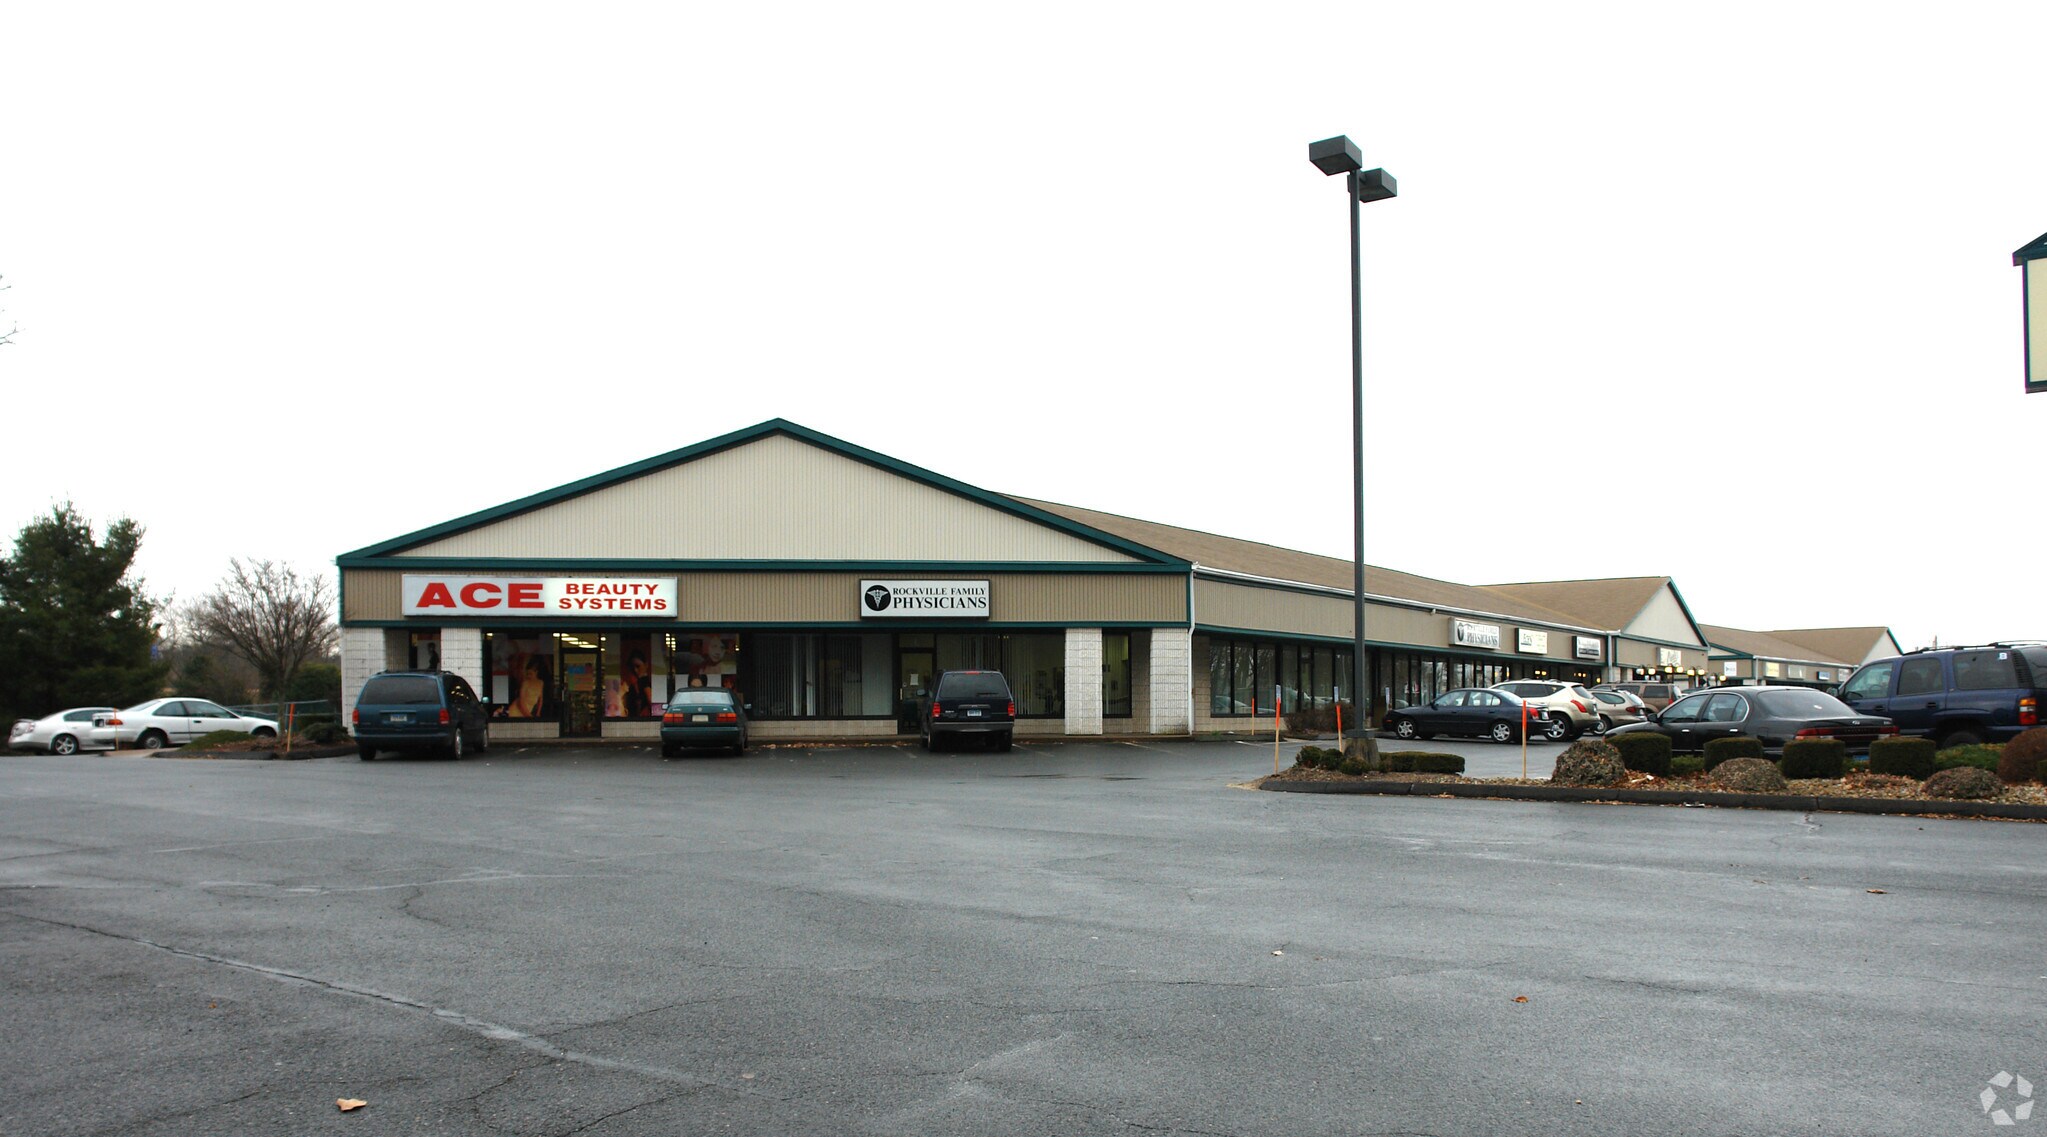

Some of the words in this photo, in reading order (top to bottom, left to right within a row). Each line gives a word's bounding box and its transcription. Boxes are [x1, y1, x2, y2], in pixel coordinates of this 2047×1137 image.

[565, 583, 659, 595] BEAUTY
[893, 587, 947, 596] ROCKVILLE
[951, 587, 987, 596] FAMILY
[416, 582, 545, 609] ACE
[558, 598, 667, 610] SYSTEMS
[893, 597, 987, 609] PHYSICIANS
